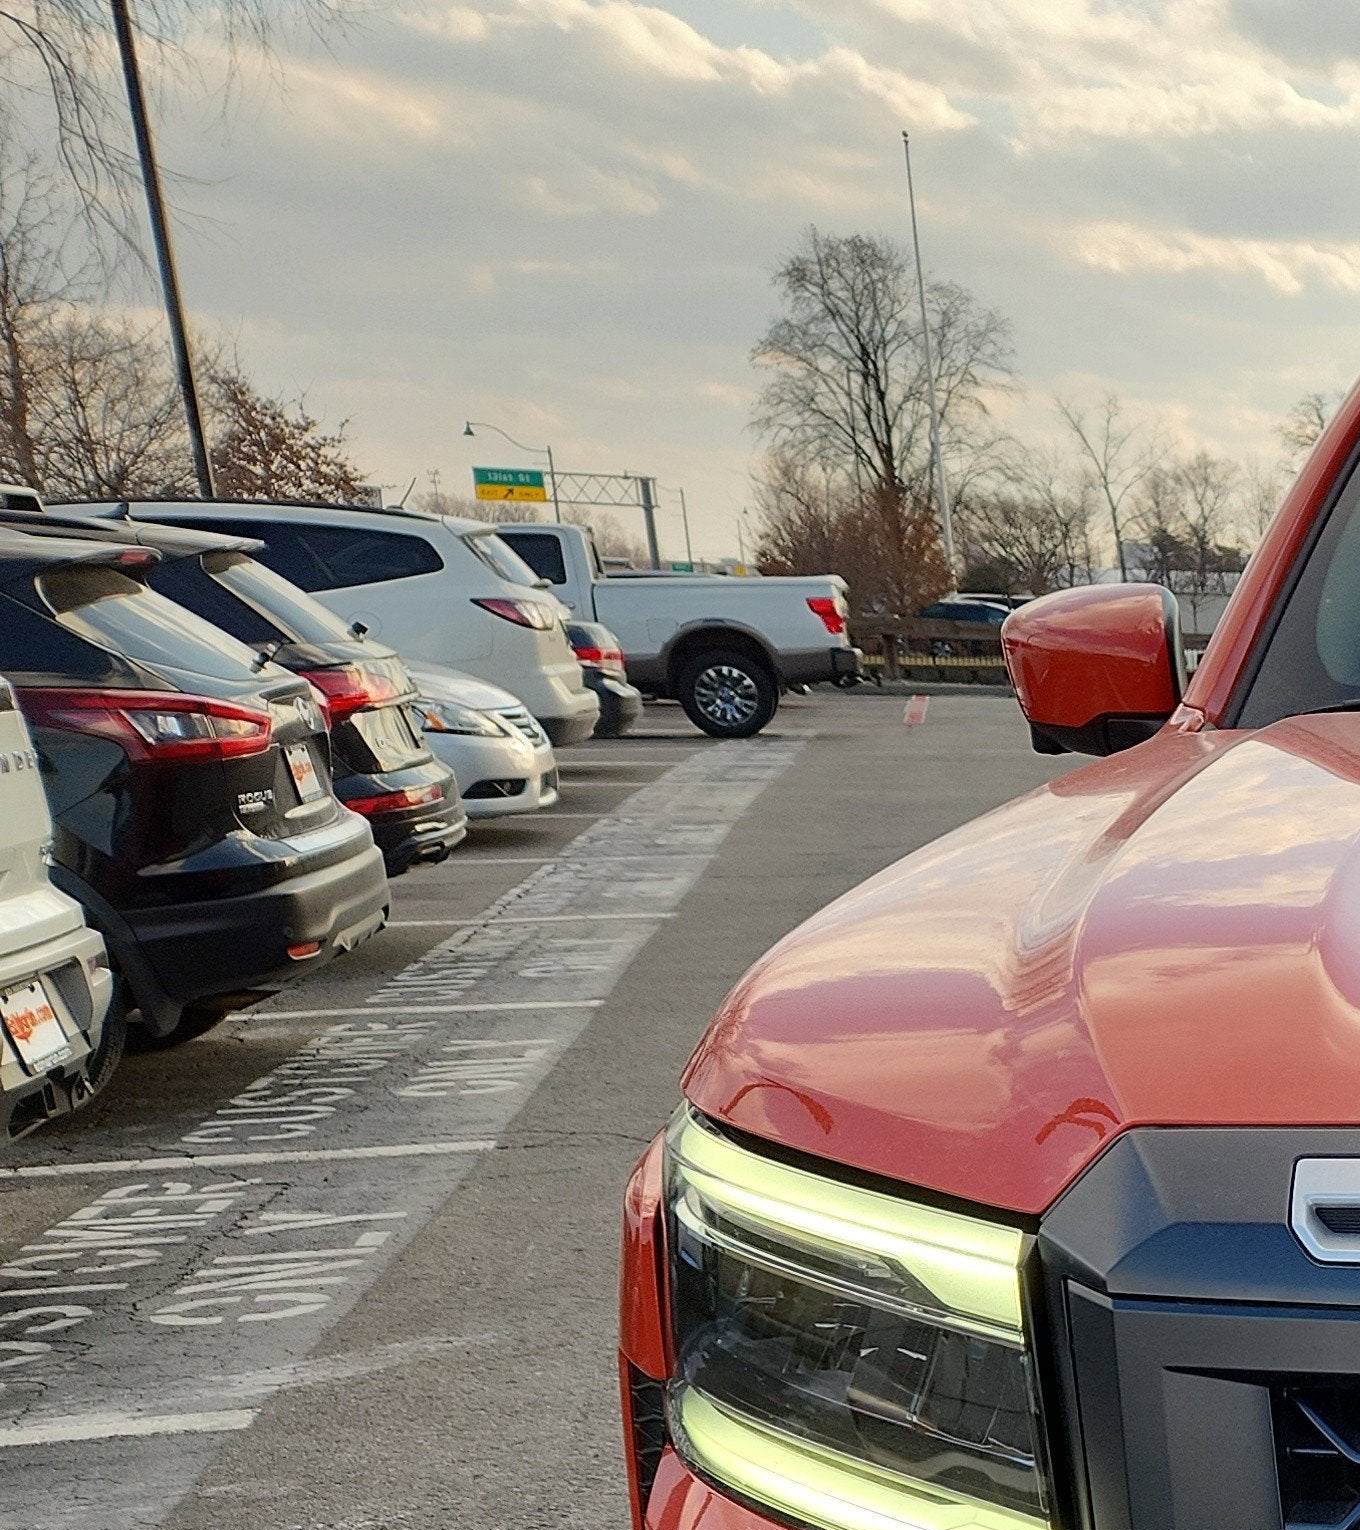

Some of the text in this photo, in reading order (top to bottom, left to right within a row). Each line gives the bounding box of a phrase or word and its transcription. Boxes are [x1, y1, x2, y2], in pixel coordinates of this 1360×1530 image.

[180, 1021, 438, 1144] CUSTOMER
[401, 1038, 555, 1097] ONLY
[149, 1211, 407, 1326] ONLY
